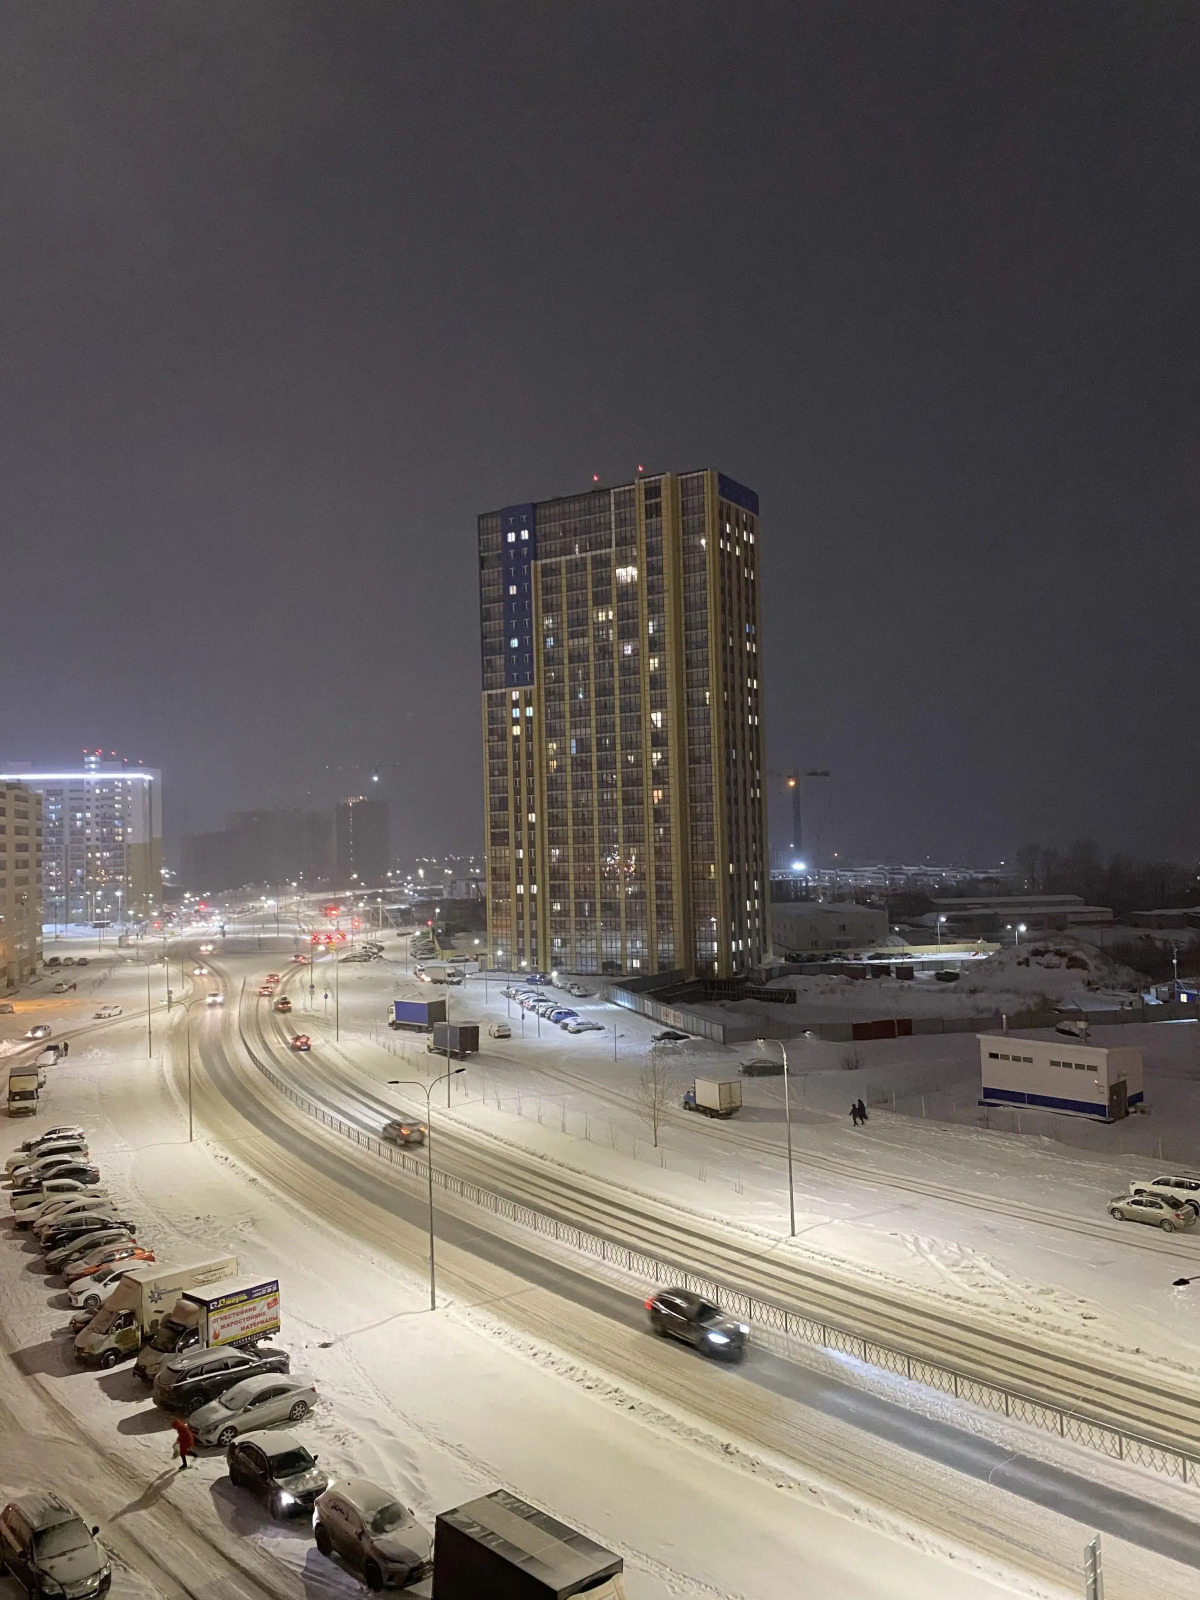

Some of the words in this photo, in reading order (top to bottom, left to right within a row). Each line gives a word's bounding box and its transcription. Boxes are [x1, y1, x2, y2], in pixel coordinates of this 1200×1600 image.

[212, 1306, 257, 1324] ОГНЕСТОЙКИЕ
[220, 1311, 266, 1330] ЖАРОСТОЙКИЕ
[240, 1315, 278, 1331] МАТЕРИАЛЫ
